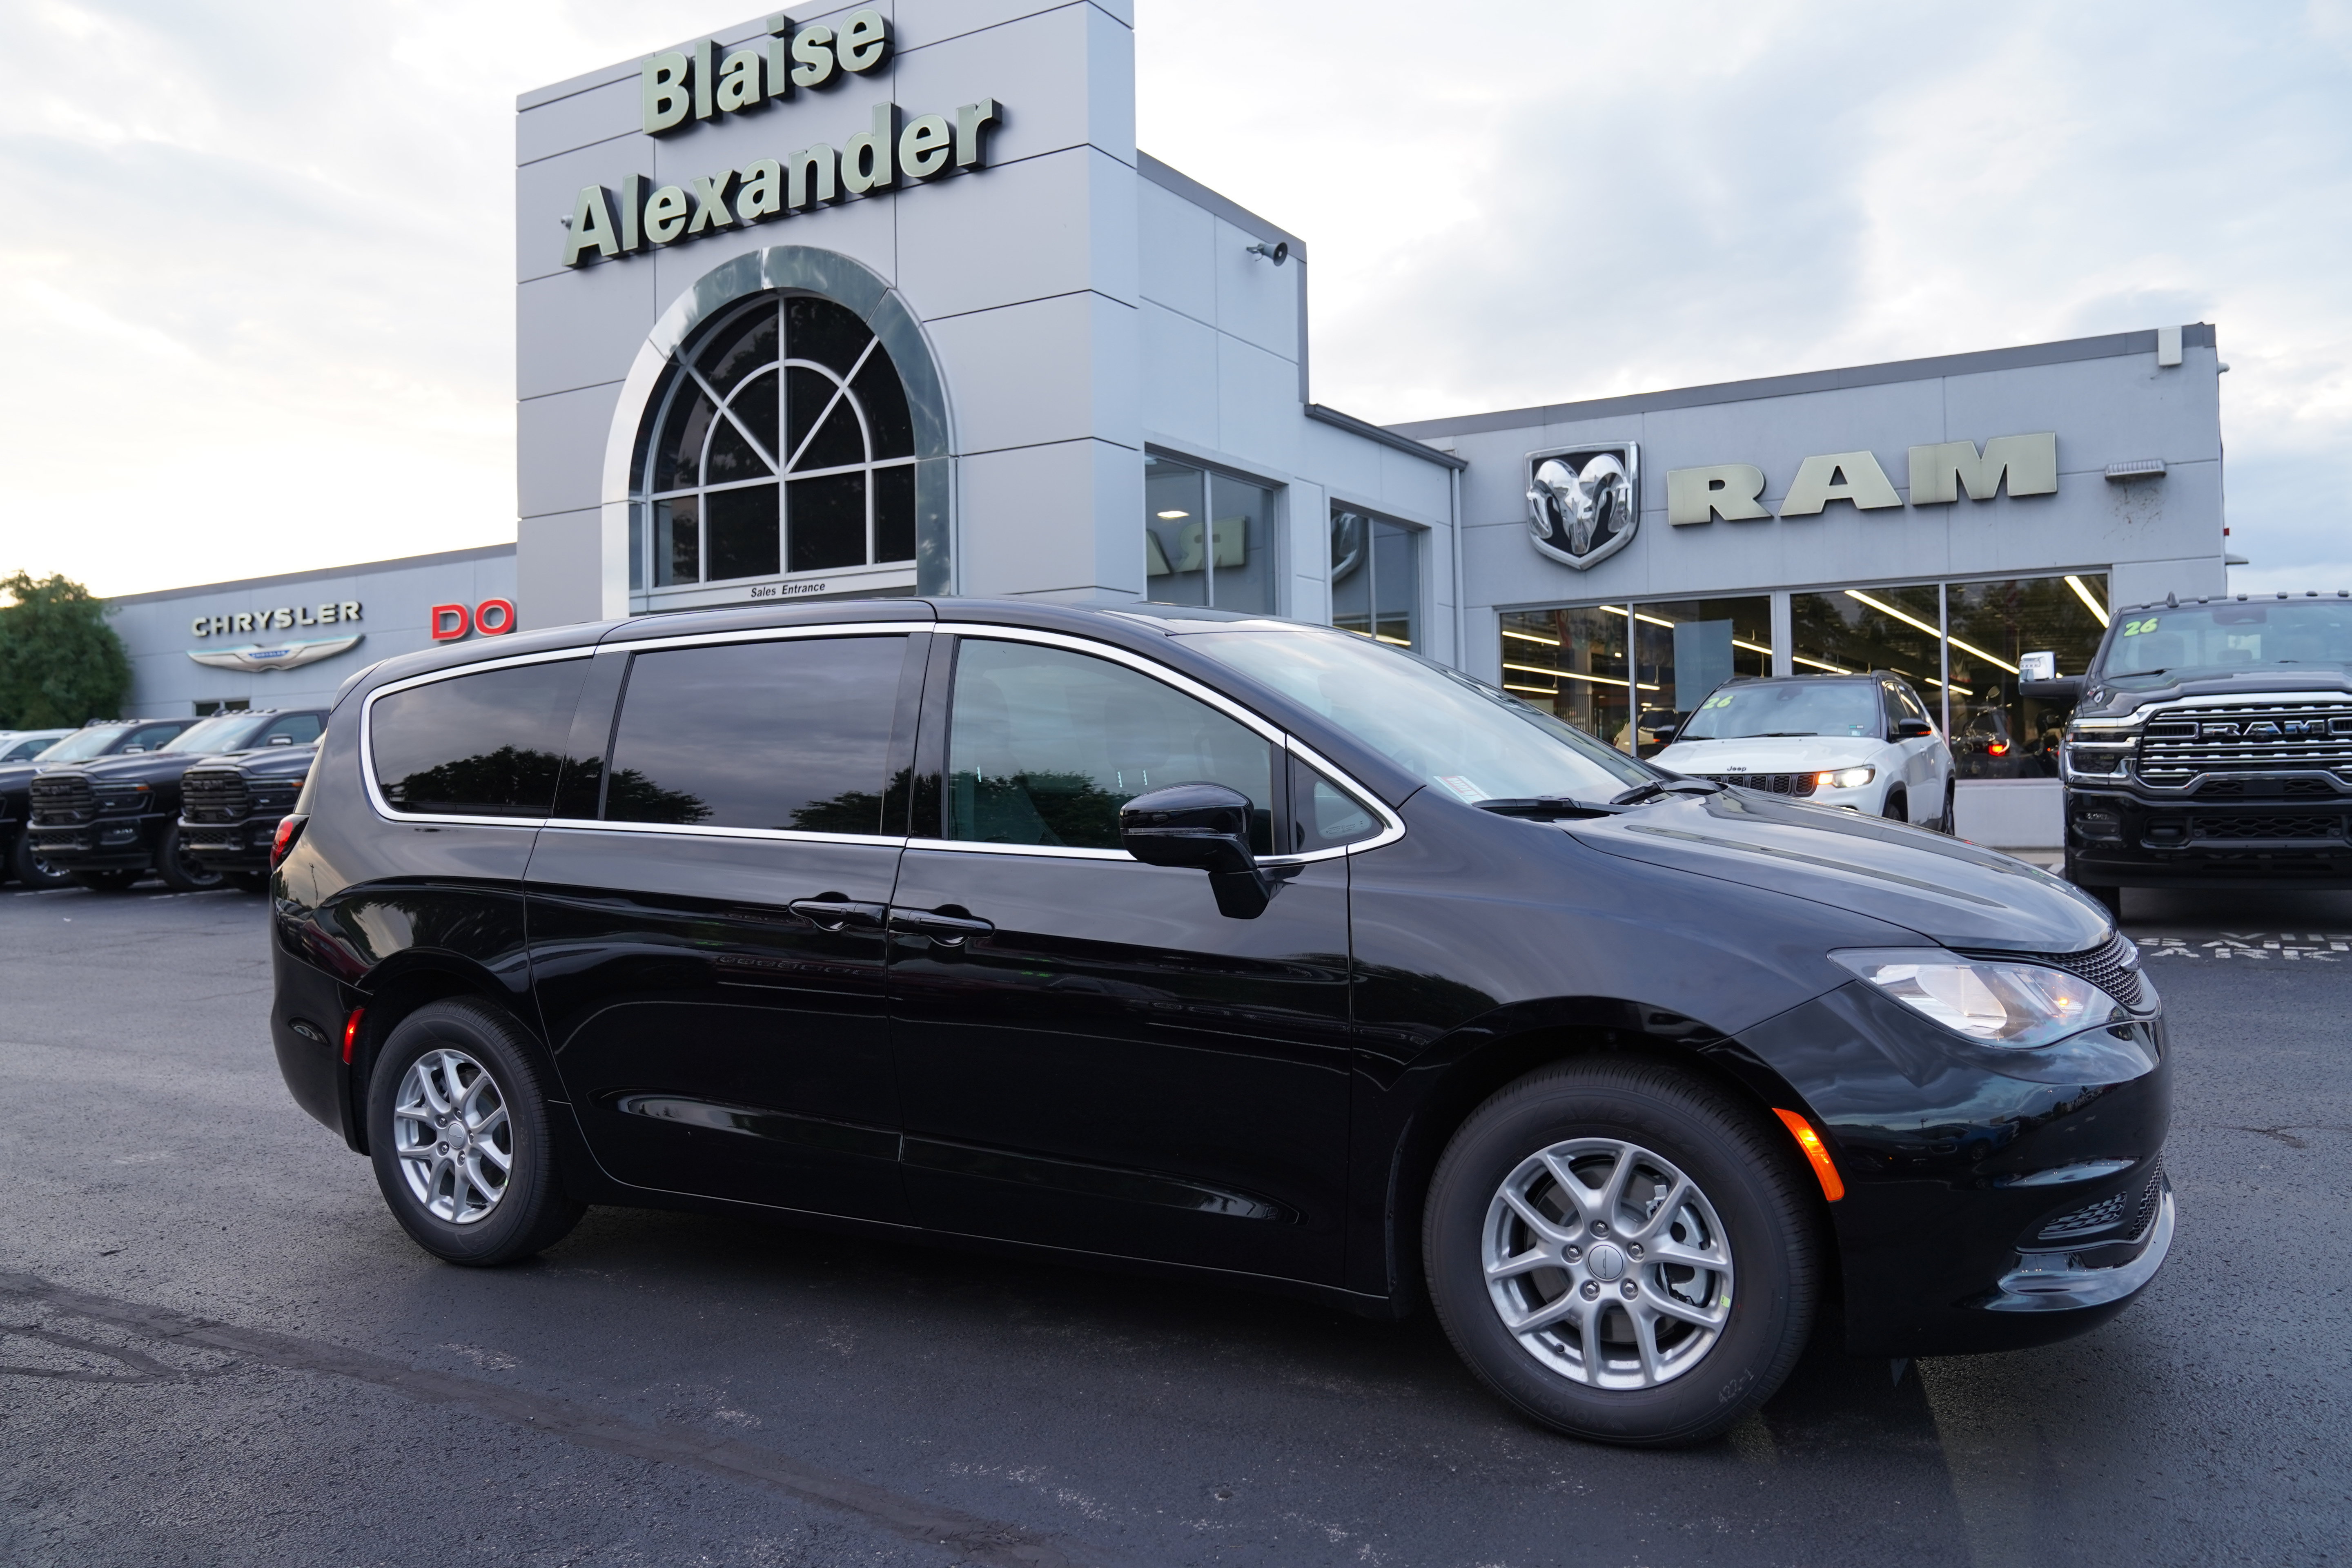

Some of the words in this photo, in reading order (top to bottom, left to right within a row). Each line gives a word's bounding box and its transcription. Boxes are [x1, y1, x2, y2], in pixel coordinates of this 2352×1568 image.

[642, 9, 890, 136] Blaise
[563, 98, 1001, 267] Alexander
[1667, 432, 2058, 526] RAM
[751, 587, 776, 597] Sales
[782, 583, 826, 595] Entrance
[191, 601, 362, 637] CHRYSLER
[431, 597, 515, 641] DO
[2124, 617, 2158, 637] 26
[1702, 695, 1734, 710] 26
[2202, 719, 2325, 736] RAM
